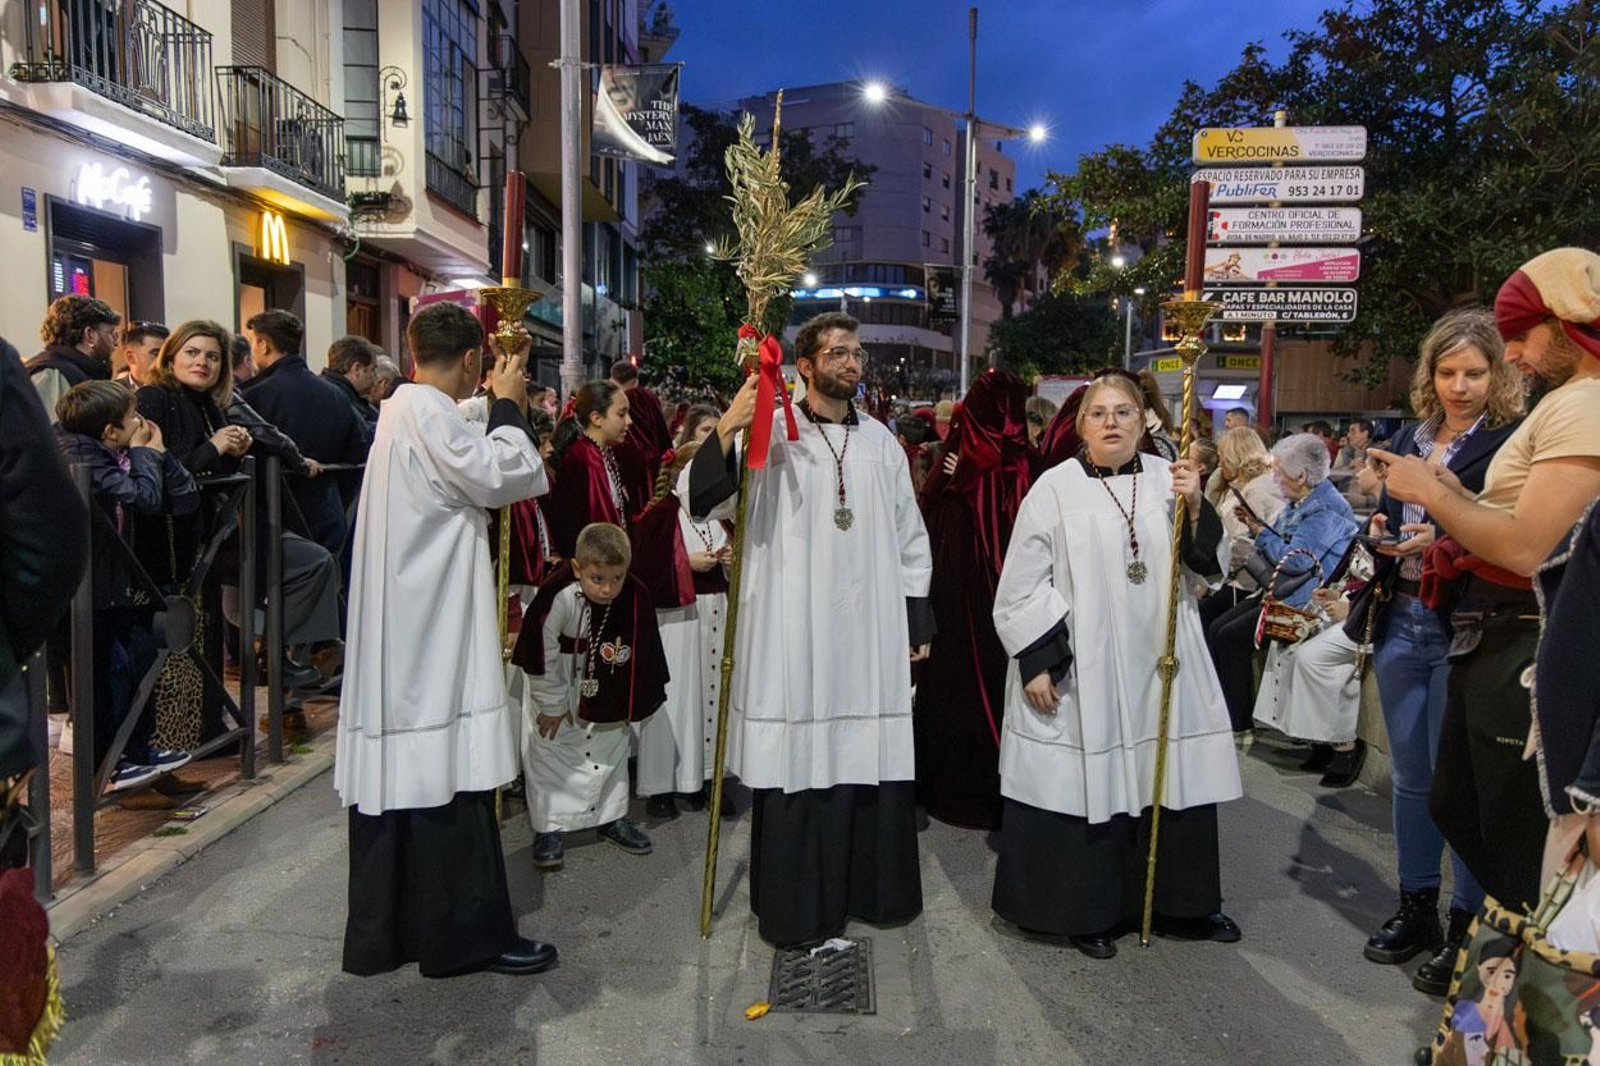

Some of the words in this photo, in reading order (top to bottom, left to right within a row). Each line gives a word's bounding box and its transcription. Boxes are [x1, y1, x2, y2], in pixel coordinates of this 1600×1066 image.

[645, 121, 672, 131] MAN
[1207, 145, 1299, 159] VERCOCINAS
[1198, 170, 1232, 182] ESPACIO
[1234, 169, 1283, 181] RESERVADO
[1284, 169, 1307, 180] PARA
[1308, 169, 1319, 180] SU
[1321, 168, 1360, 180] EMPRESA
[1289, 186, 1309, 197] 953
[1312, 185, 1326, 196] 24
[1330, 185, 1343, 196] 17
[1346, 185, 1359, 196] 01
[1248, 210, 1285, 220] CENTRO
[1288, 210, 1324, 220] OFICIAL
[1327, 210, 1341, 219] DE
[1232, 219, 1287, 230] FORMACIÓN
[1289, 220, 1355, 230] PROFESIONAL
[1222, 292, 1255, 303] CAFE
[1259, 292, 1286, 303] BAR
[1288, 291, 1354, 303] MANOLO
[1160, 360, 1180, 369] ONCE
[1229, 358, 1258, 367] ONCE
